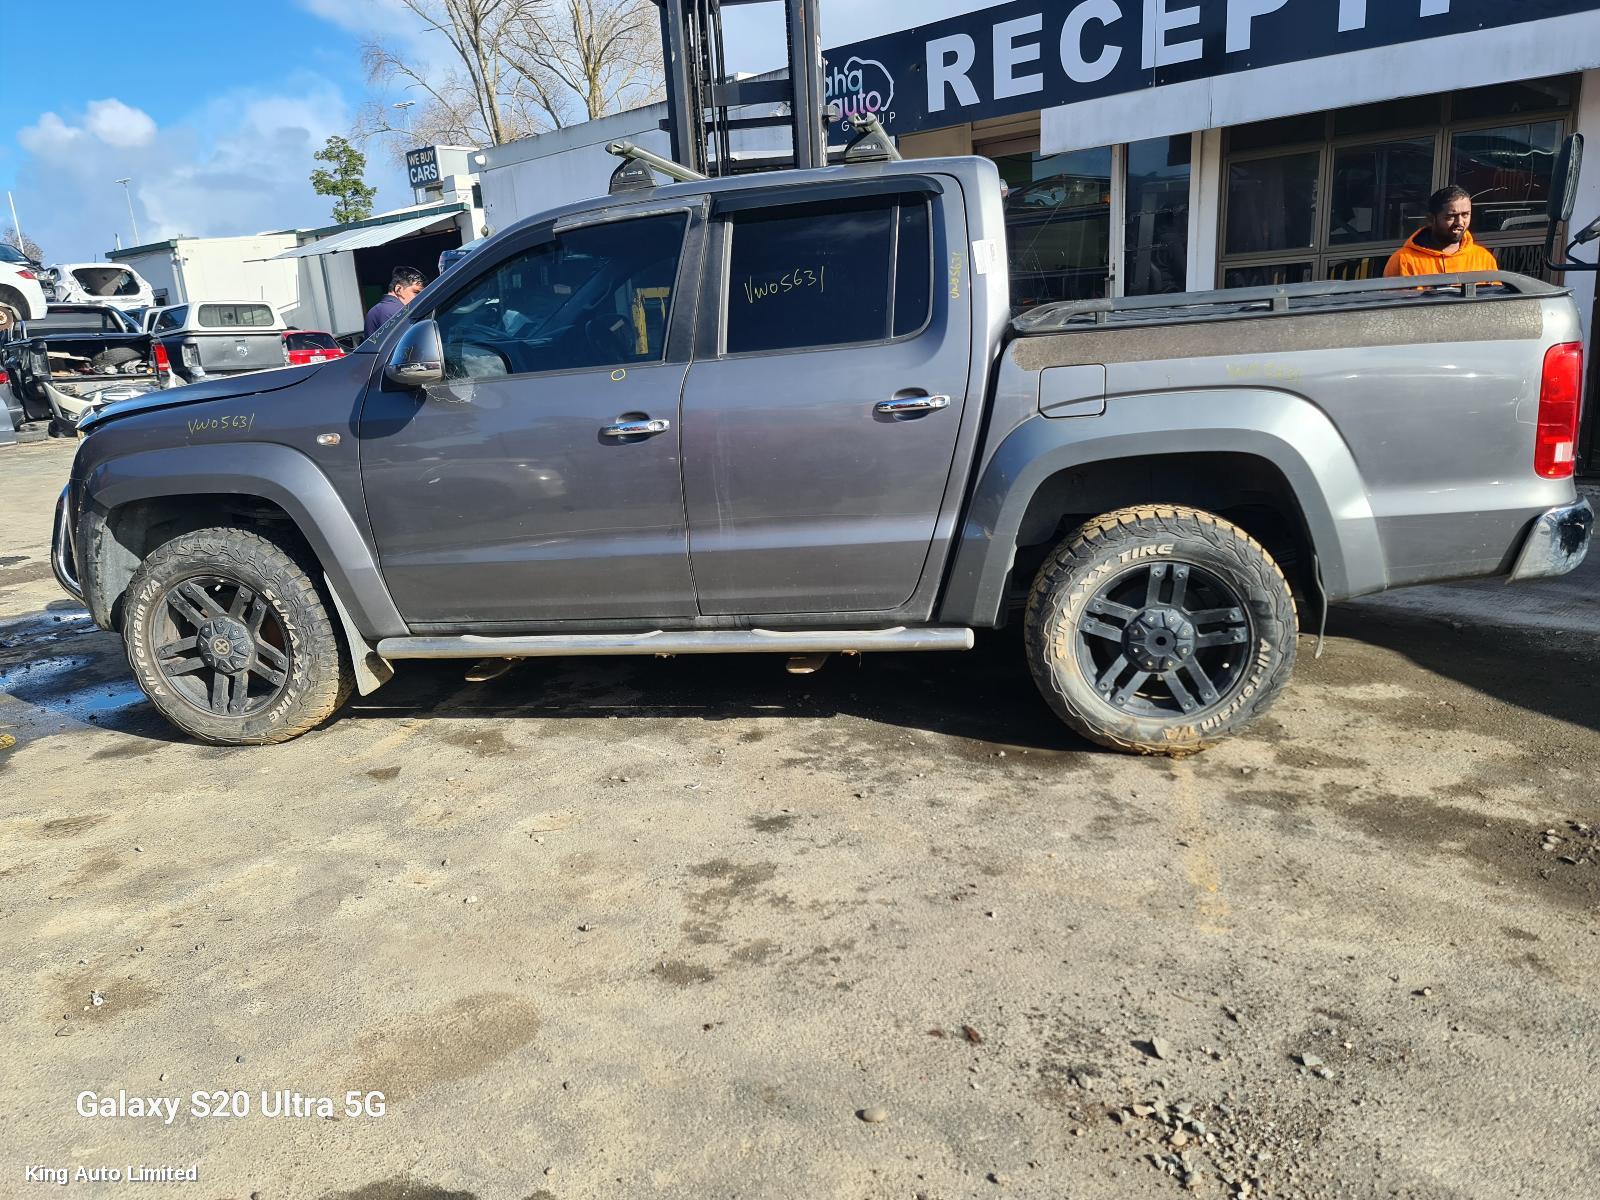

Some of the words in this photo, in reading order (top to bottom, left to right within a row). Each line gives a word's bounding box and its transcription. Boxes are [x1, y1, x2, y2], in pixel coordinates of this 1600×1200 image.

[925, 0, 1451, 114] RECEP
[829, 91, 881, 119] auto
[841, 112, 896, 131] GUP
[408, 153, 420, 166] WE
[421, 150, 434, 164] BUY
[410, 164, 437, 183] CARS
[1118, 543, 1174, 563] TIRE
[268, 688, 296, 720] TIRE
